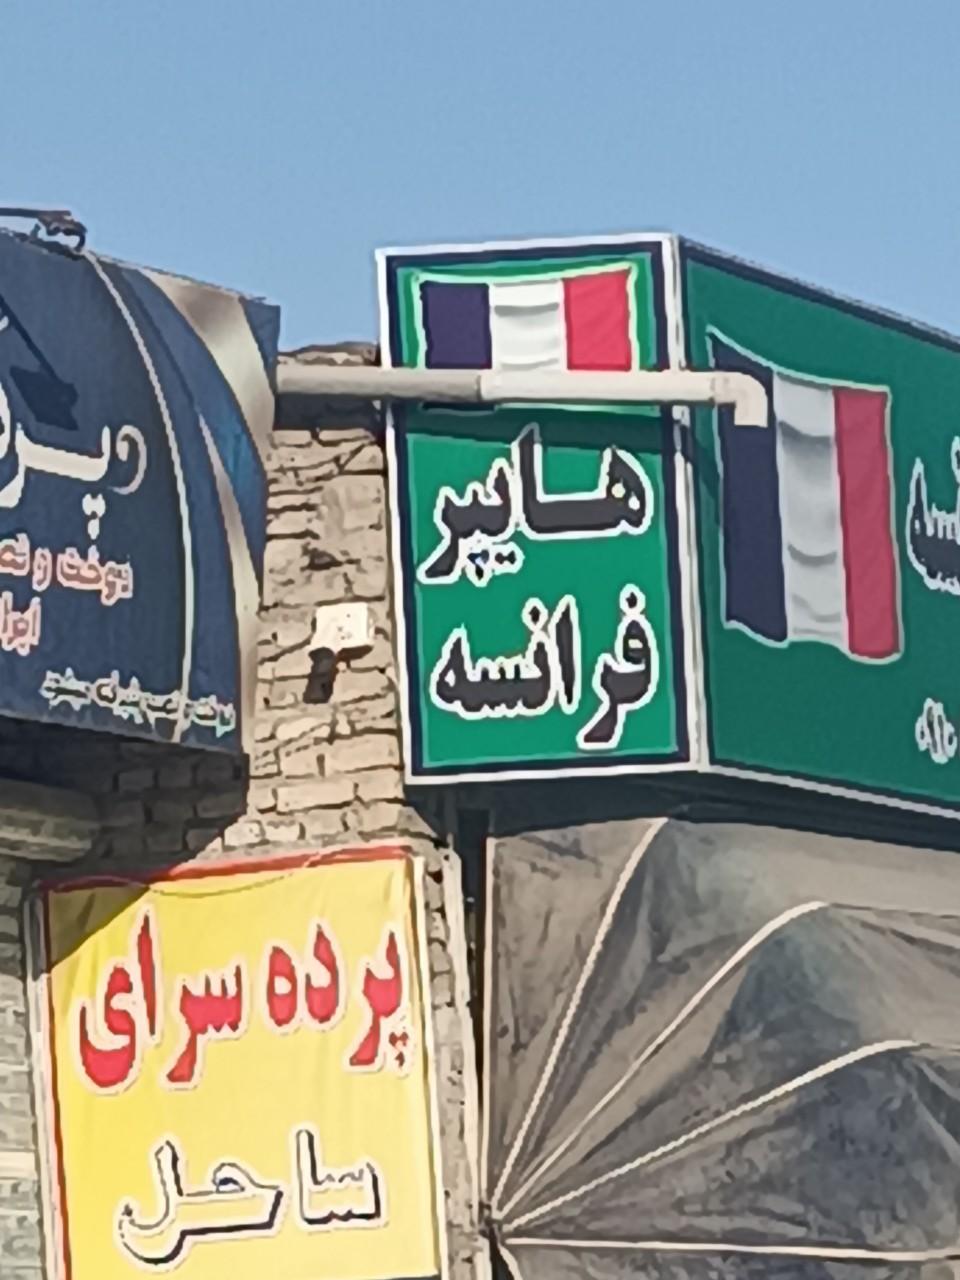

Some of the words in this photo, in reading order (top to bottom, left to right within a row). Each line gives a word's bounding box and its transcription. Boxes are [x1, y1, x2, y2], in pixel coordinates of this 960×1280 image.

[418, 423, 654, 587] هایپر
[430, 584, 659, 749] فرانسه
[76, 904, 245, 1094] سرای
[265, 921, 412, 1078] پرده
[117, 1124, 389, 1273] ساحل
